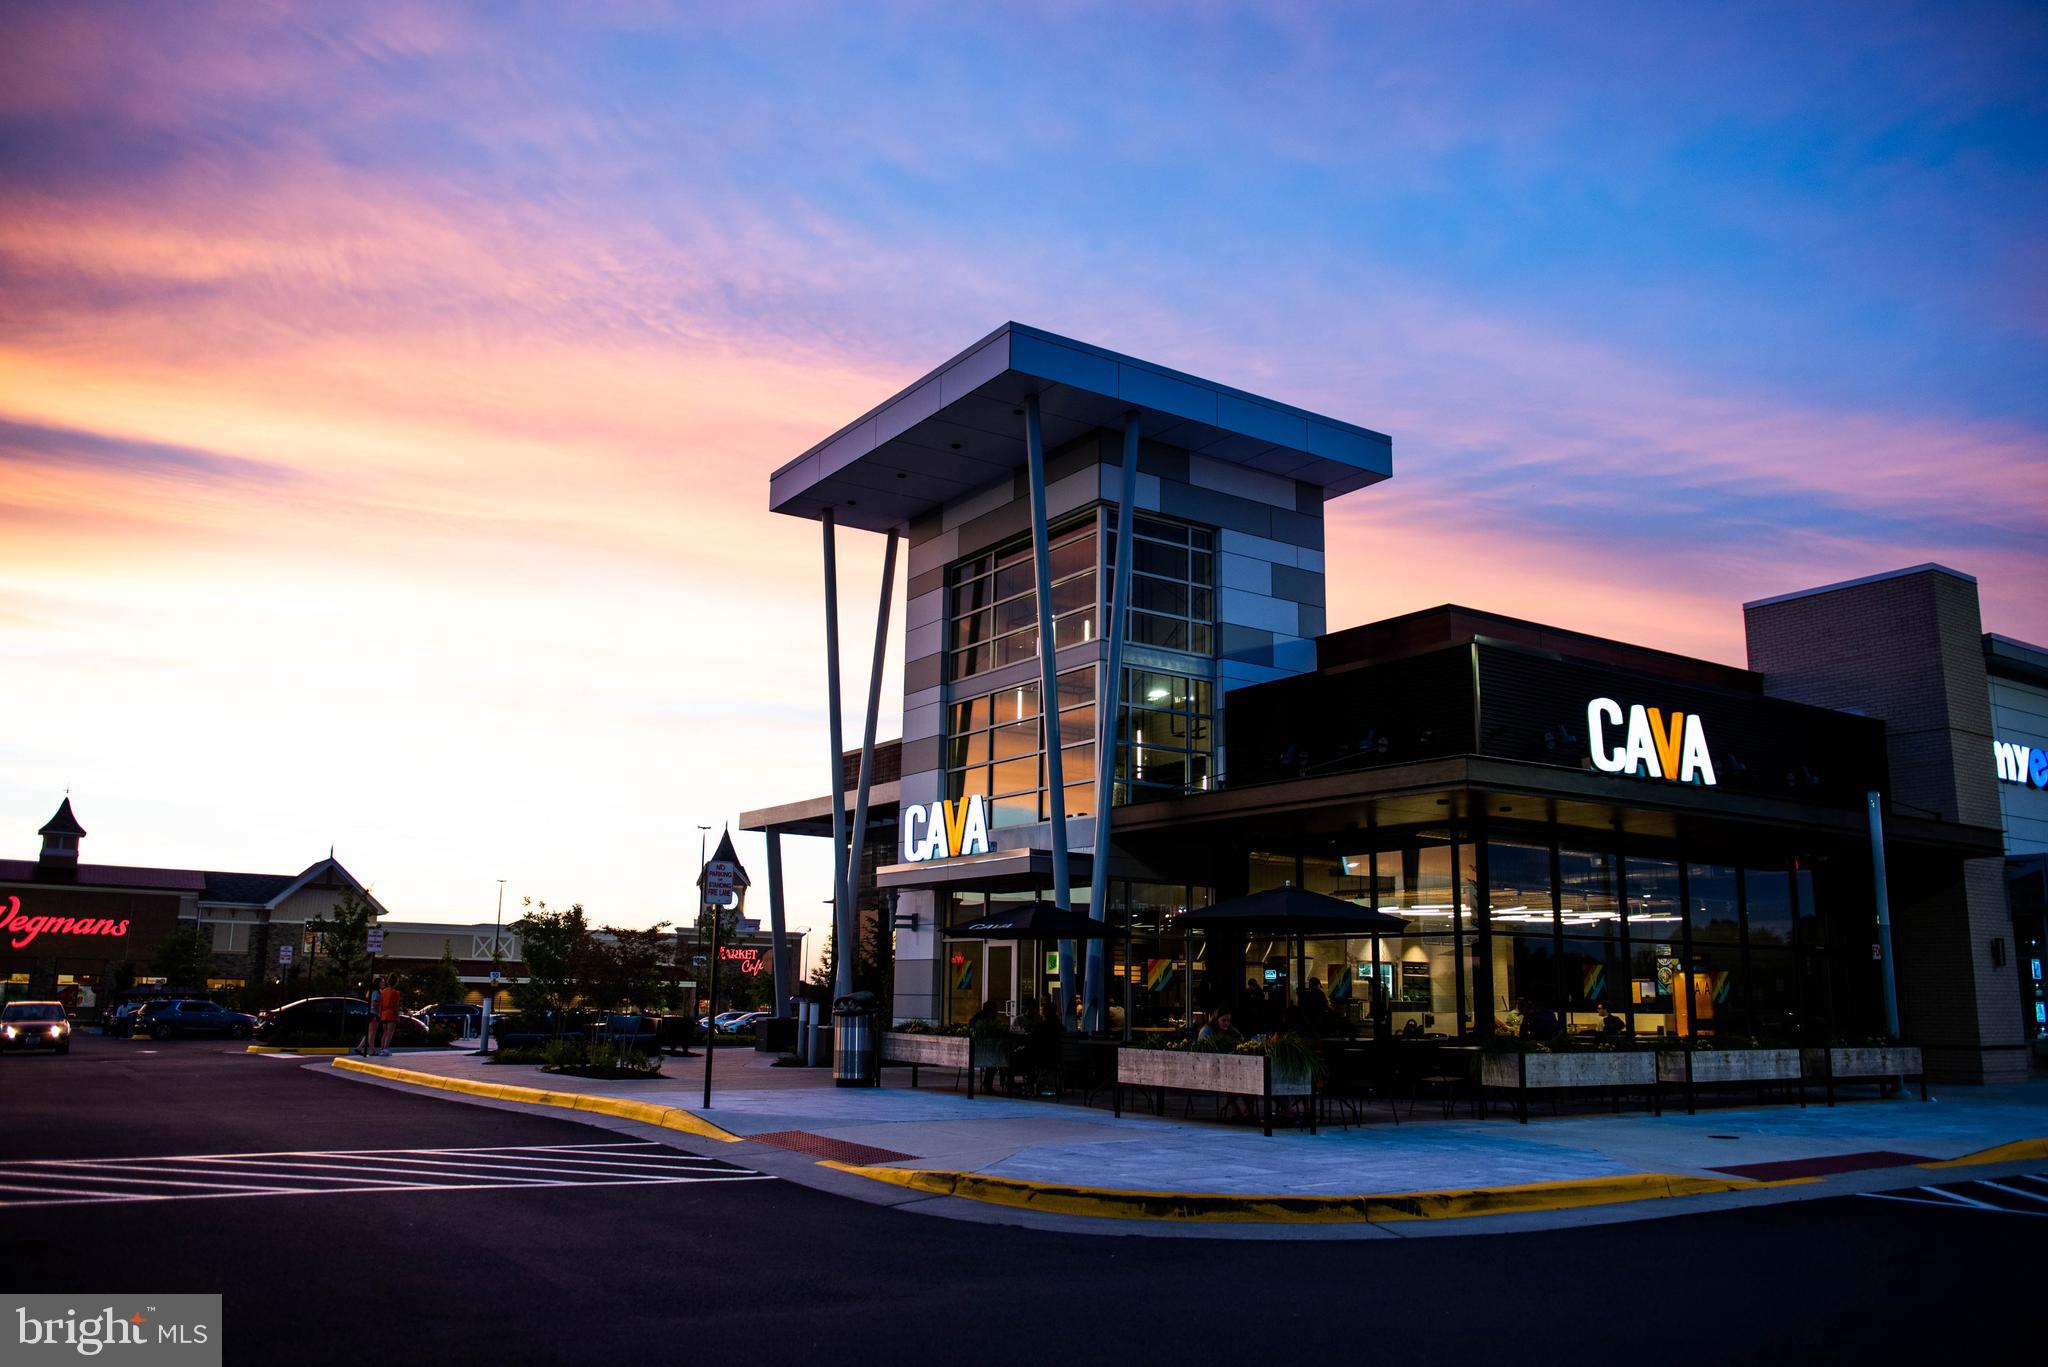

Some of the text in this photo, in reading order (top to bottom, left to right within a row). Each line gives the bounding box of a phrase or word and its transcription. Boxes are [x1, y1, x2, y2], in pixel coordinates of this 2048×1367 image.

[1587, 697, 1717, 785] CAVA
[904, 794, 990, 862] CAVA
[708, 881, 732, 889] STANDING
[709, 870, 732, 878] PARKING
